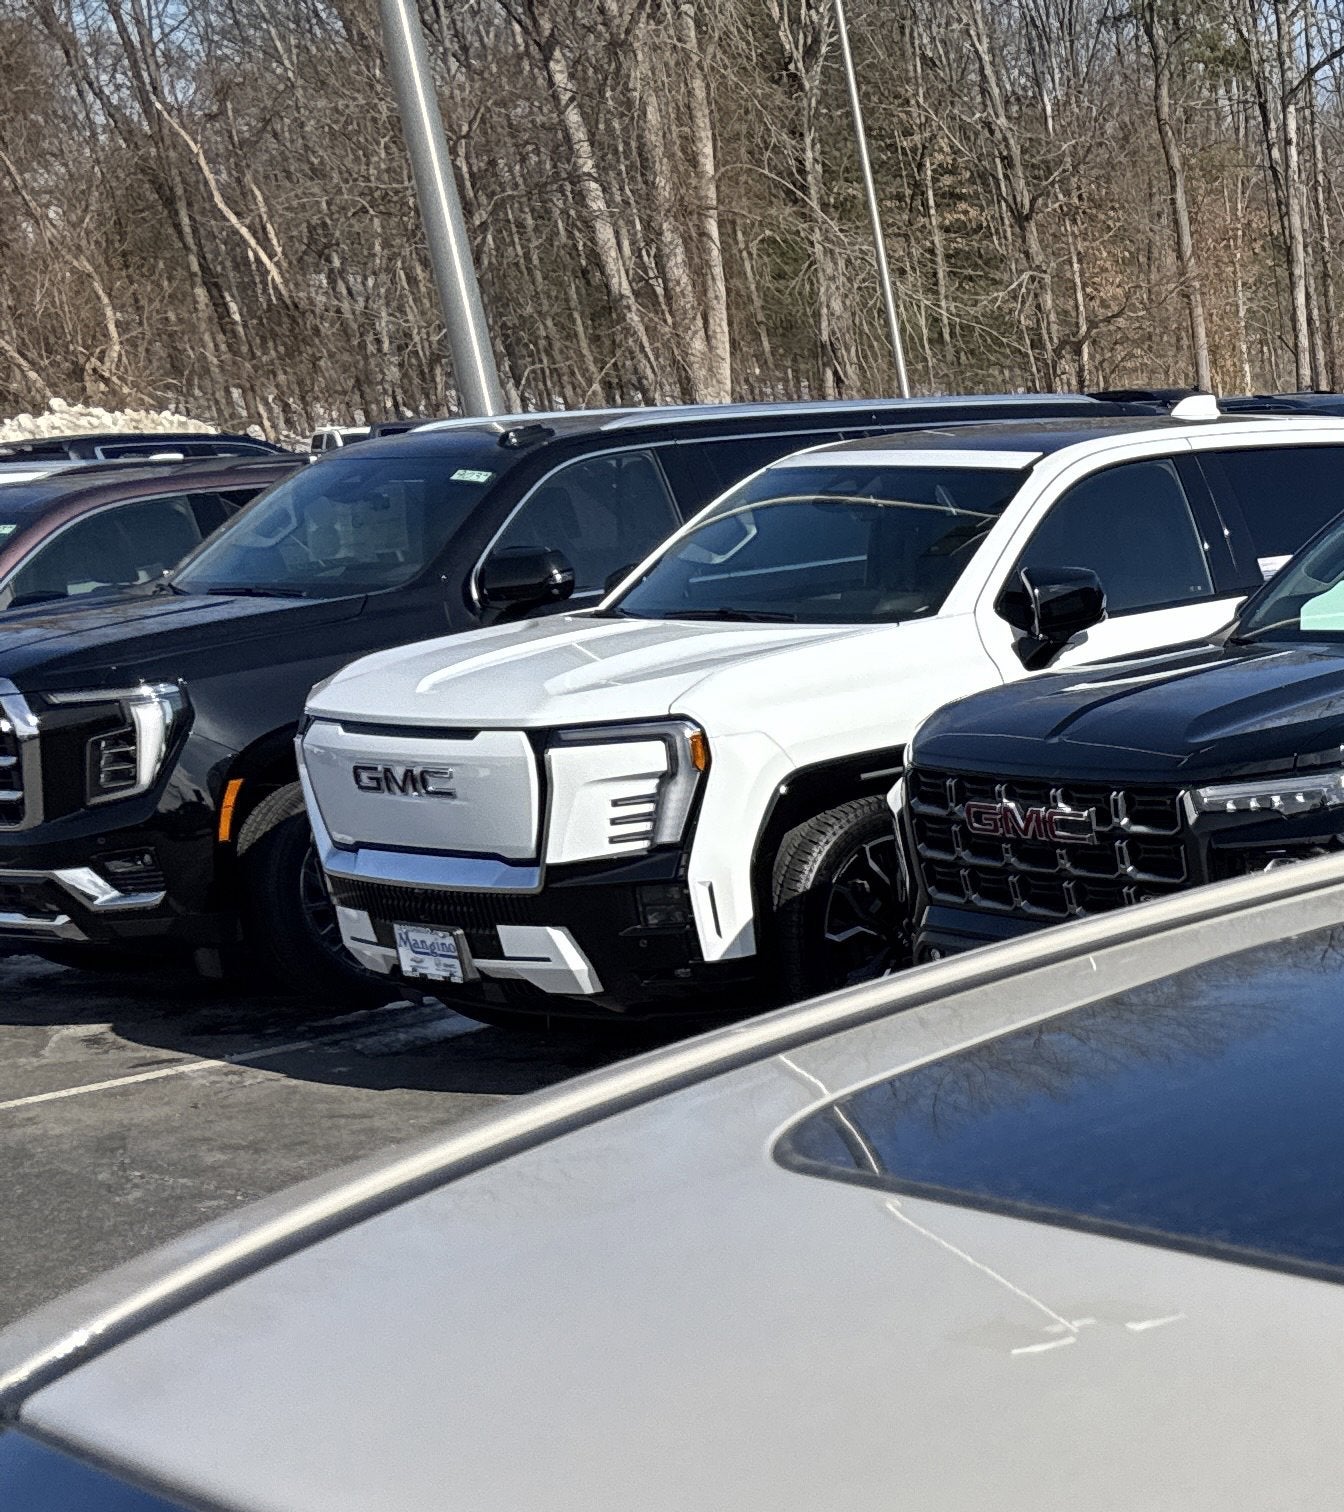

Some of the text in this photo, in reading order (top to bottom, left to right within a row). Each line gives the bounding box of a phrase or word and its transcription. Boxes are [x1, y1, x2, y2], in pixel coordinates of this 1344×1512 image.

[353, 762, 457, 799] GMC
[965, 801, 1093, 844] GMC
[398, 931, 458, 957] Mangino
